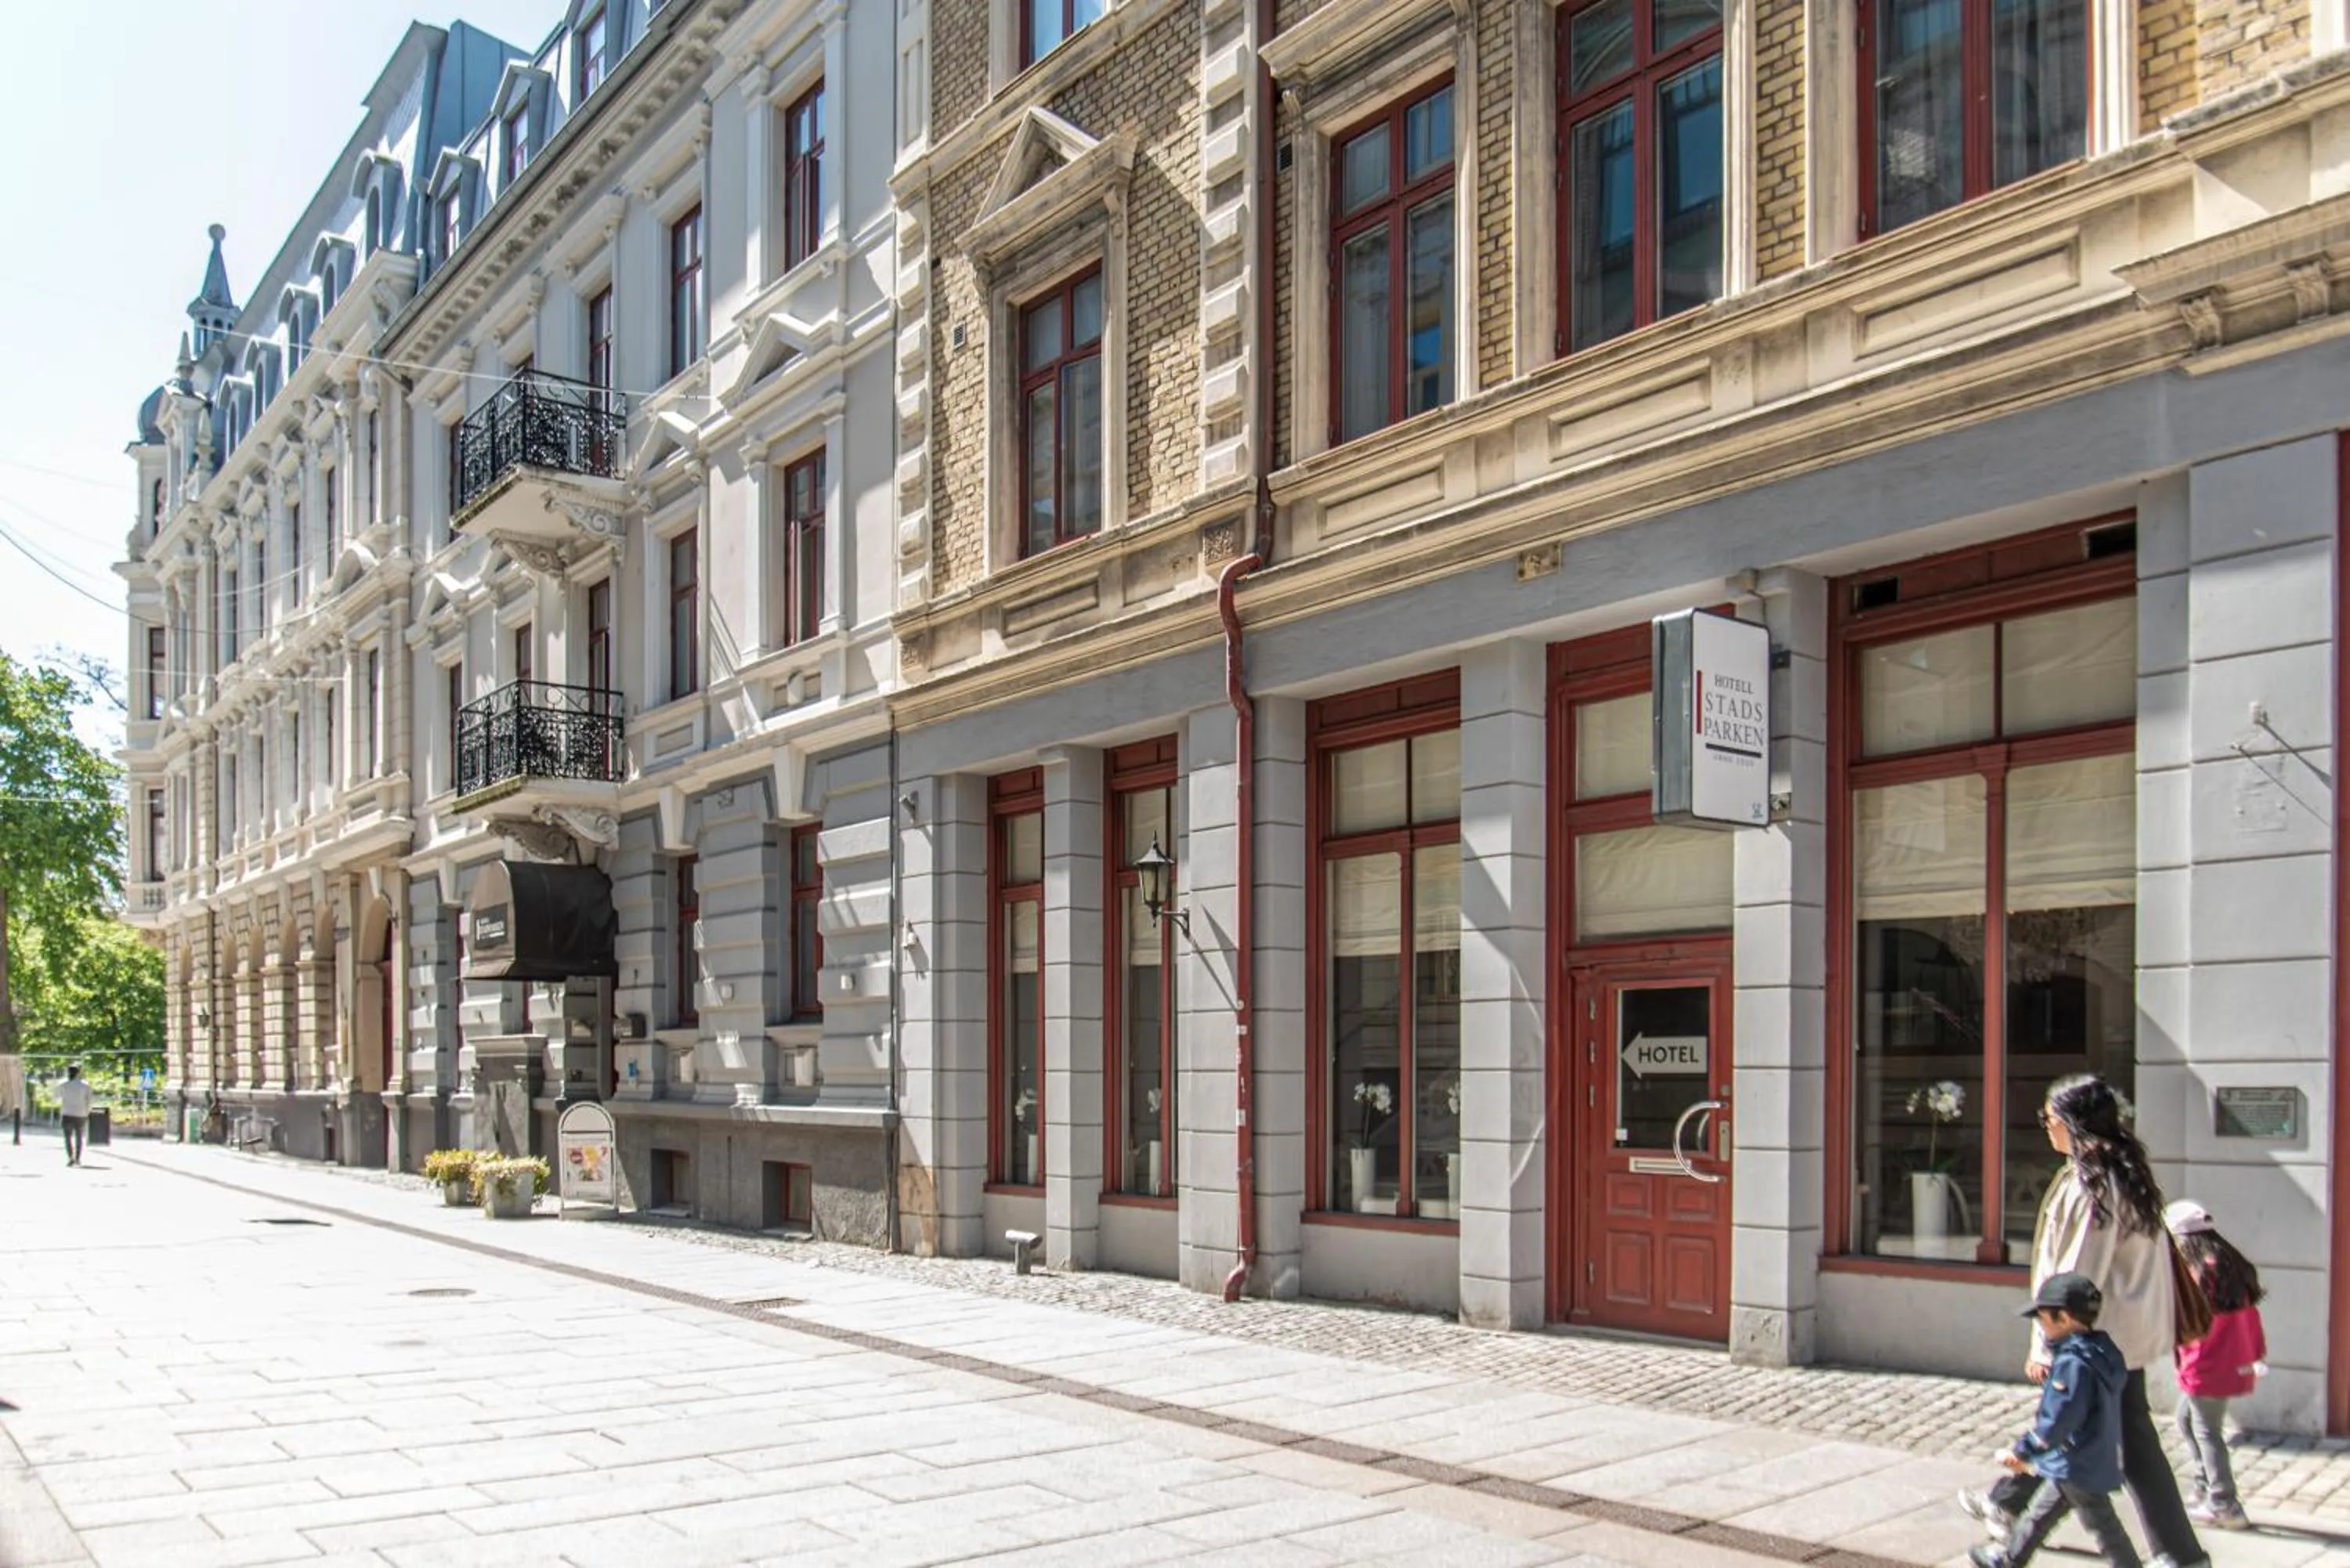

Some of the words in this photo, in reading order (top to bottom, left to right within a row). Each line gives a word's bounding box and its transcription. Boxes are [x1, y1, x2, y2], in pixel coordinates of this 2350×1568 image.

[1714, 674, 1755, 695] HOTELL
[1705, 692, 1762, 723] STADS
[1705, 717, 1764, 746] PARKEN
[1638, 1046, 1699, 1064] HOTEL
